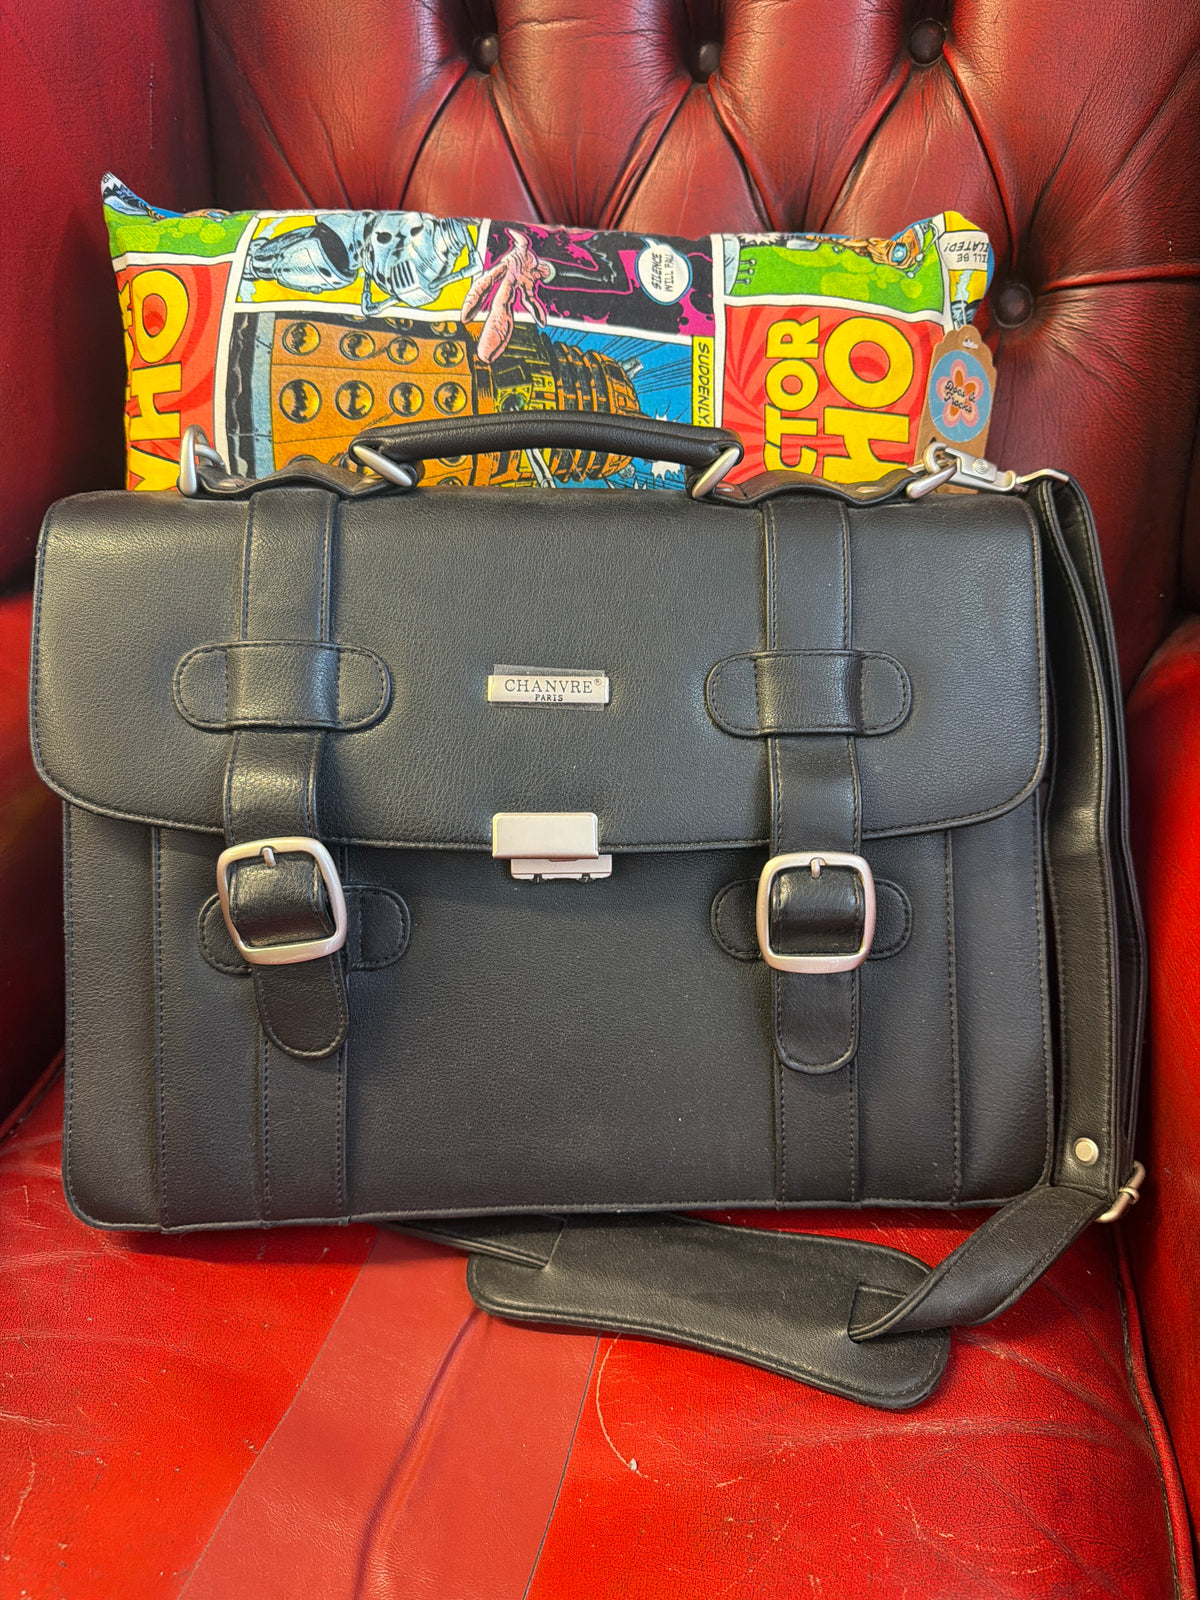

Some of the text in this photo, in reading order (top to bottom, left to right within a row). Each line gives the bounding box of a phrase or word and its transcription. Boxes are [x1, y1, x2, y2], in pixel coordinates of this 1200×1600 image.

[956, 253, 988, 263] ILL BE
[650, 252, 663, 291] SILENCE
[663, 270, 675, 293] WILL
[534, 694, 564, 702] PARIS
